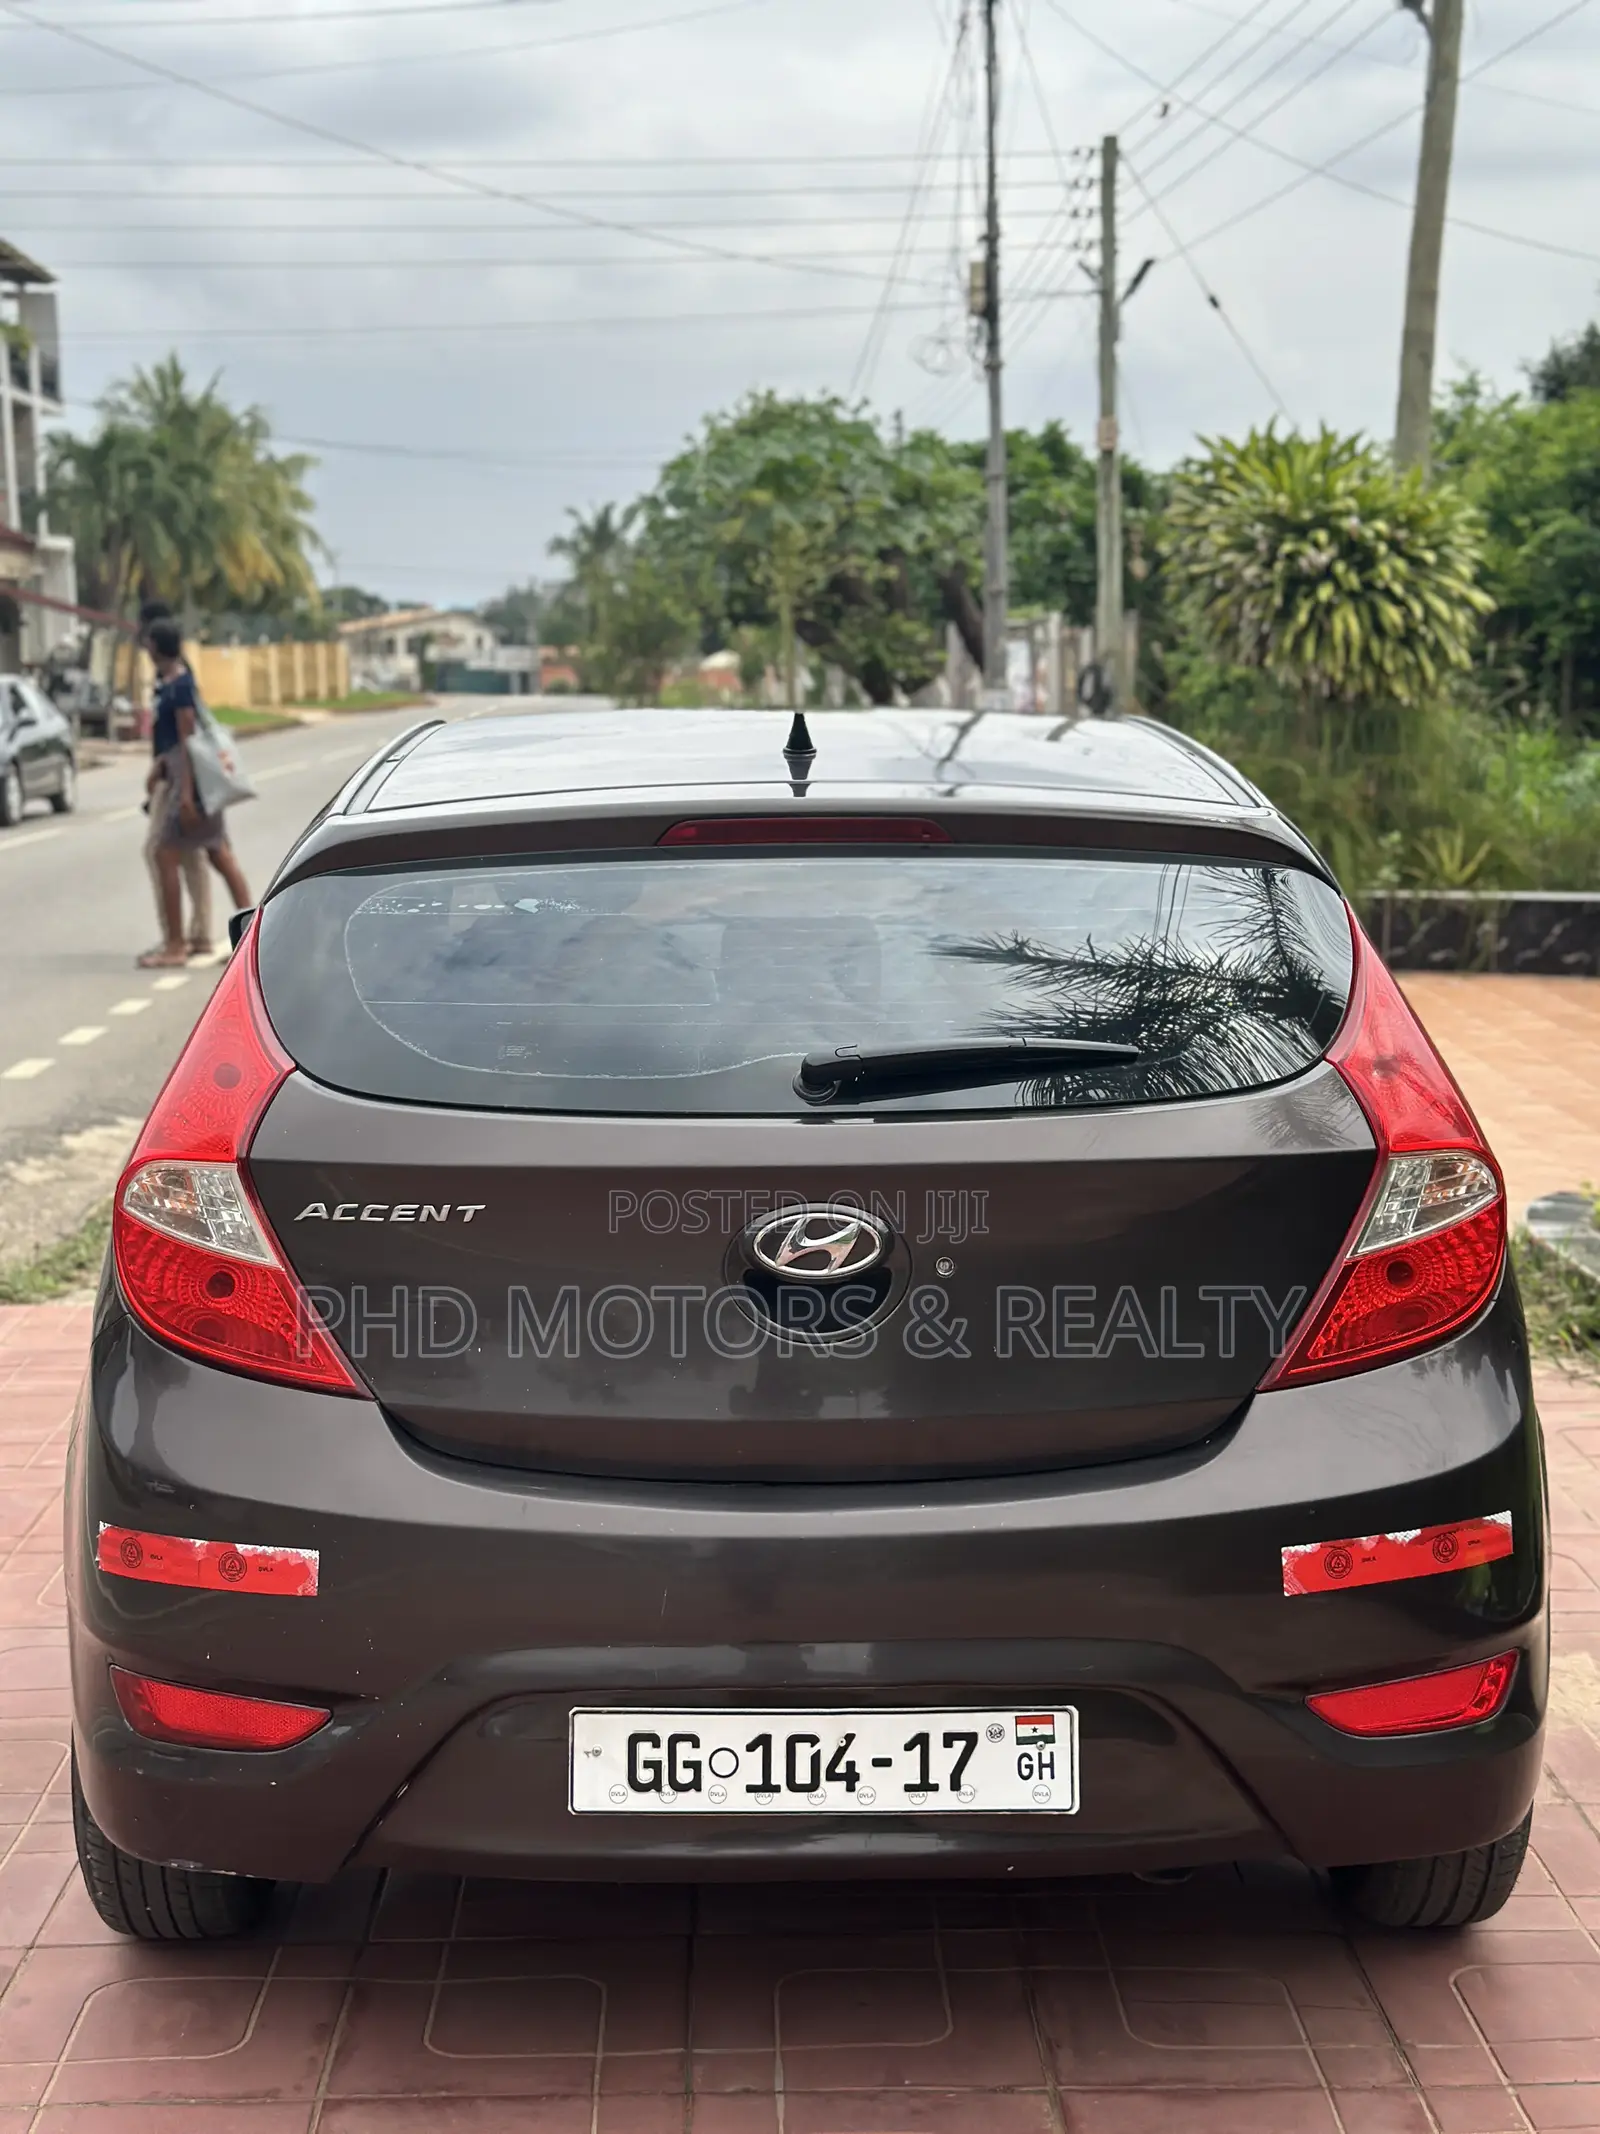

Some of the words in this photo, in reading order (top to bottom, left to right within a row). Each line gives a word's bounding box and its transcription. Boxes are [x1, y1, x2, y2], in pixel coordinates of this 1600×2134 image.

[294, 1202, 487, 1224] ACCENT
[627, 1732, 702, 1792] GG
[745, 1732, 978, 1793] 104-17
[1017, 1751, 1055, 1781] GH
